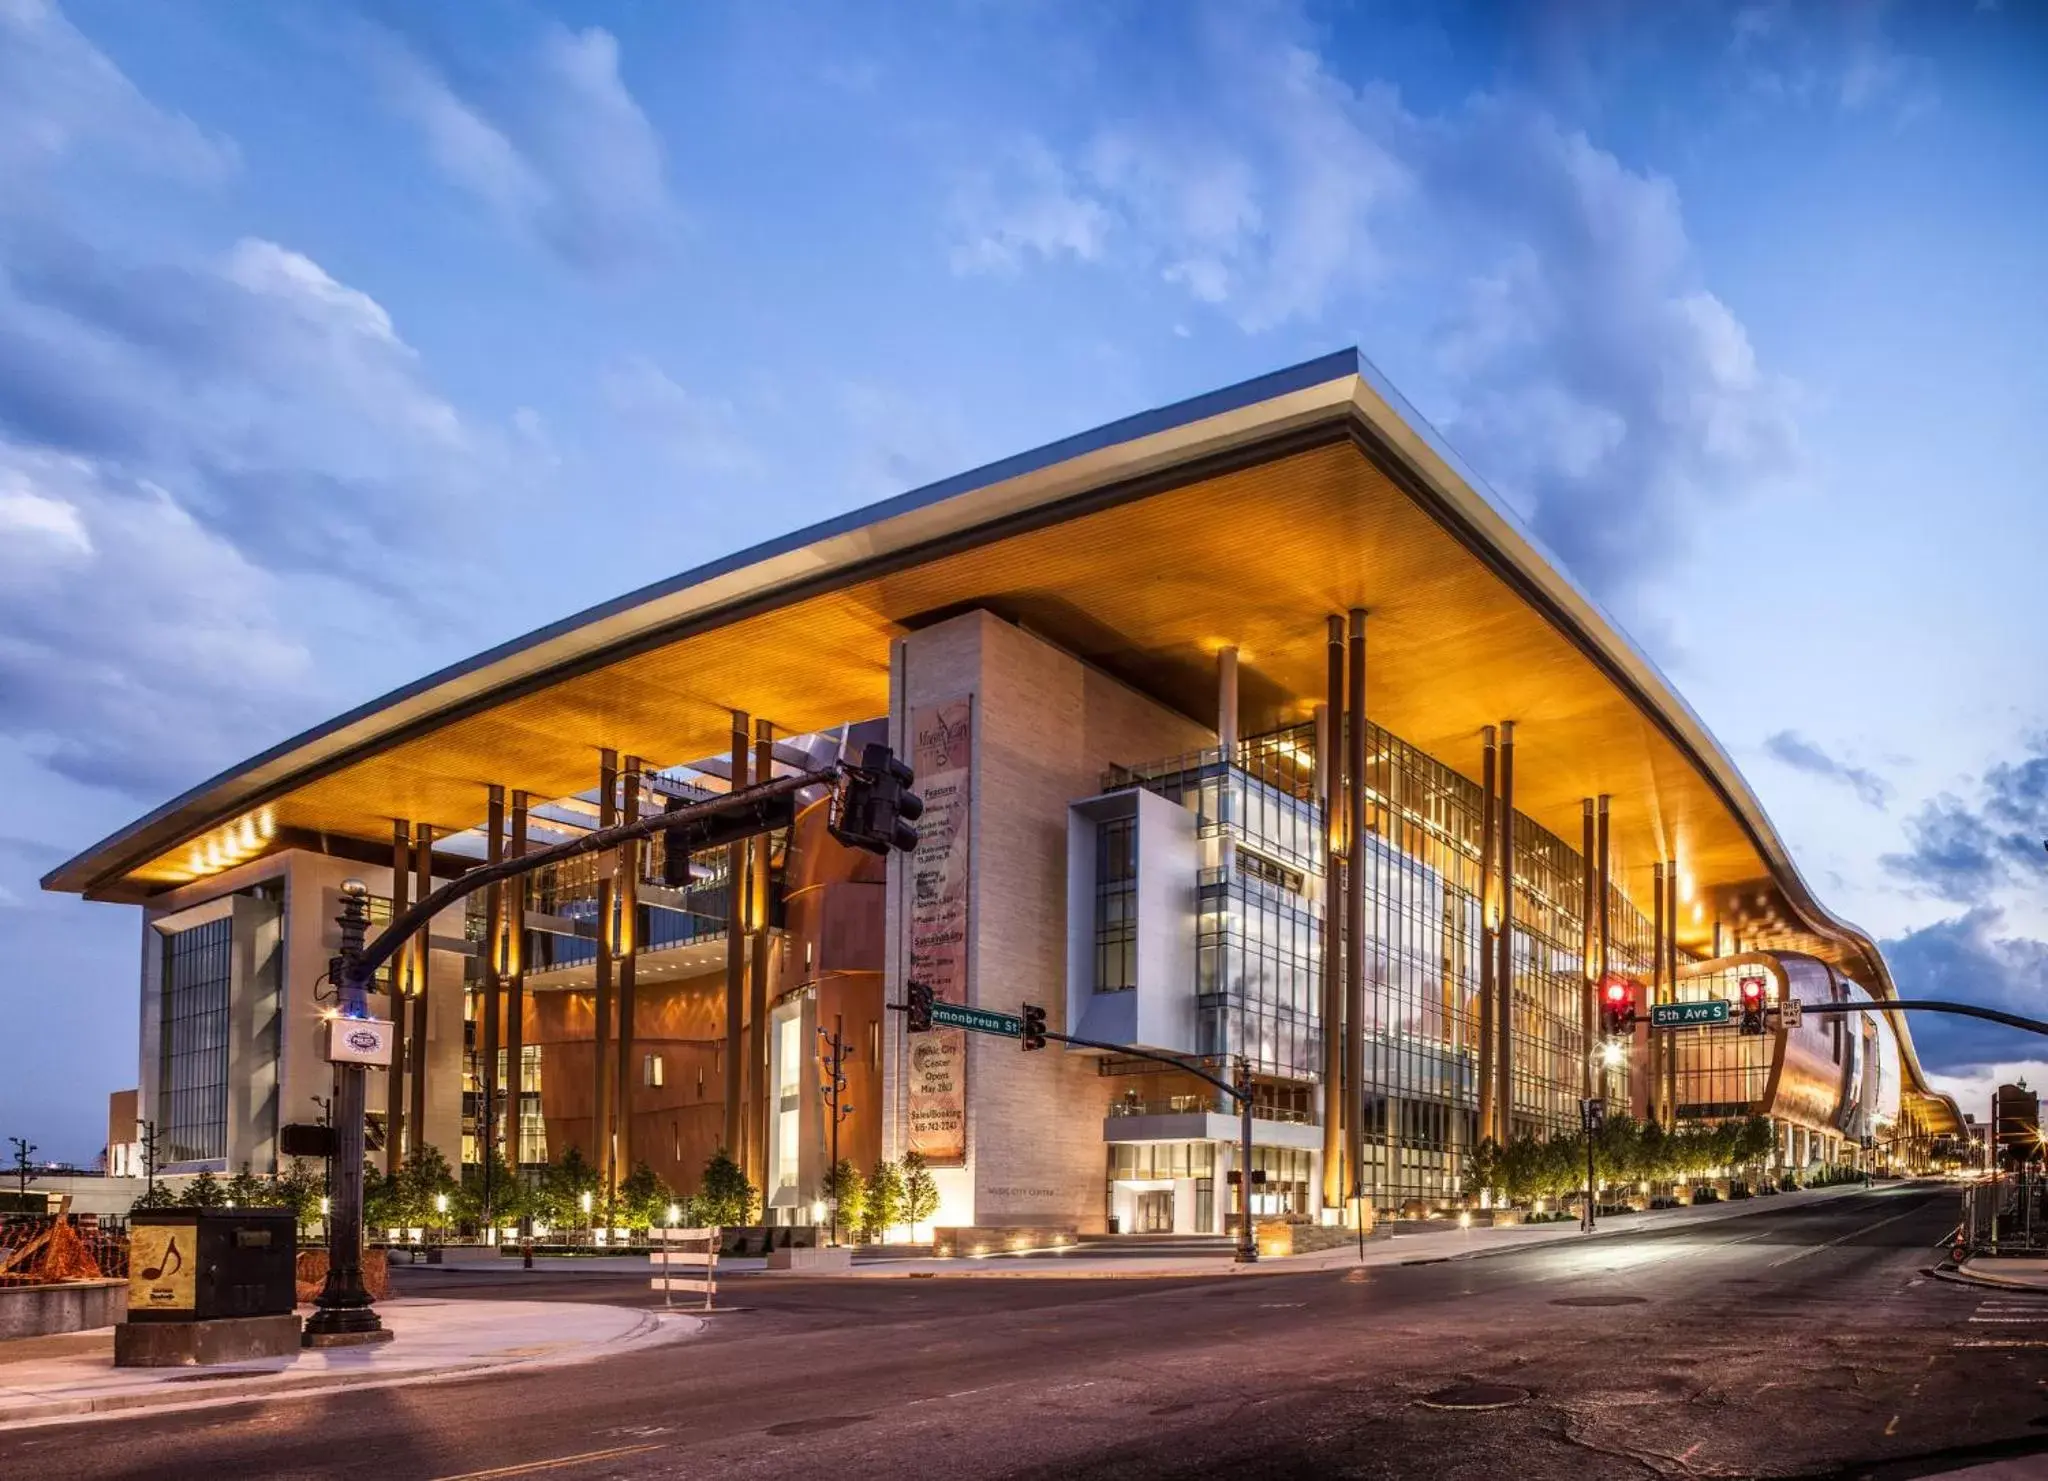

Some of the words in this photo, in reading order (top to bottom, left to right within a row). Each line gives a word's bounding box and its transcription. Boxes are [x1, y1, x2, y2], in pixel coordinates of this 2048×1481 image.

[1783, 1002, 1799, 1010] ONE
[1658, 1009, 1679, 1022] 5th
[1684, 1008, 1708, 1020] Ave
[1712, 1006, 1722, 1017] S
[1783, 1010, 1800, 1018] WAY
[932, 1012, 999, 1029] emonbreun
[1004, 1020, 1018, 1032] St
[941, 1045, 956, 1055] City
[924, 1060, 951, 1068] Center
[925, 1072, 949, 1082] Opens
[921, 1085, 936, 1094] May
